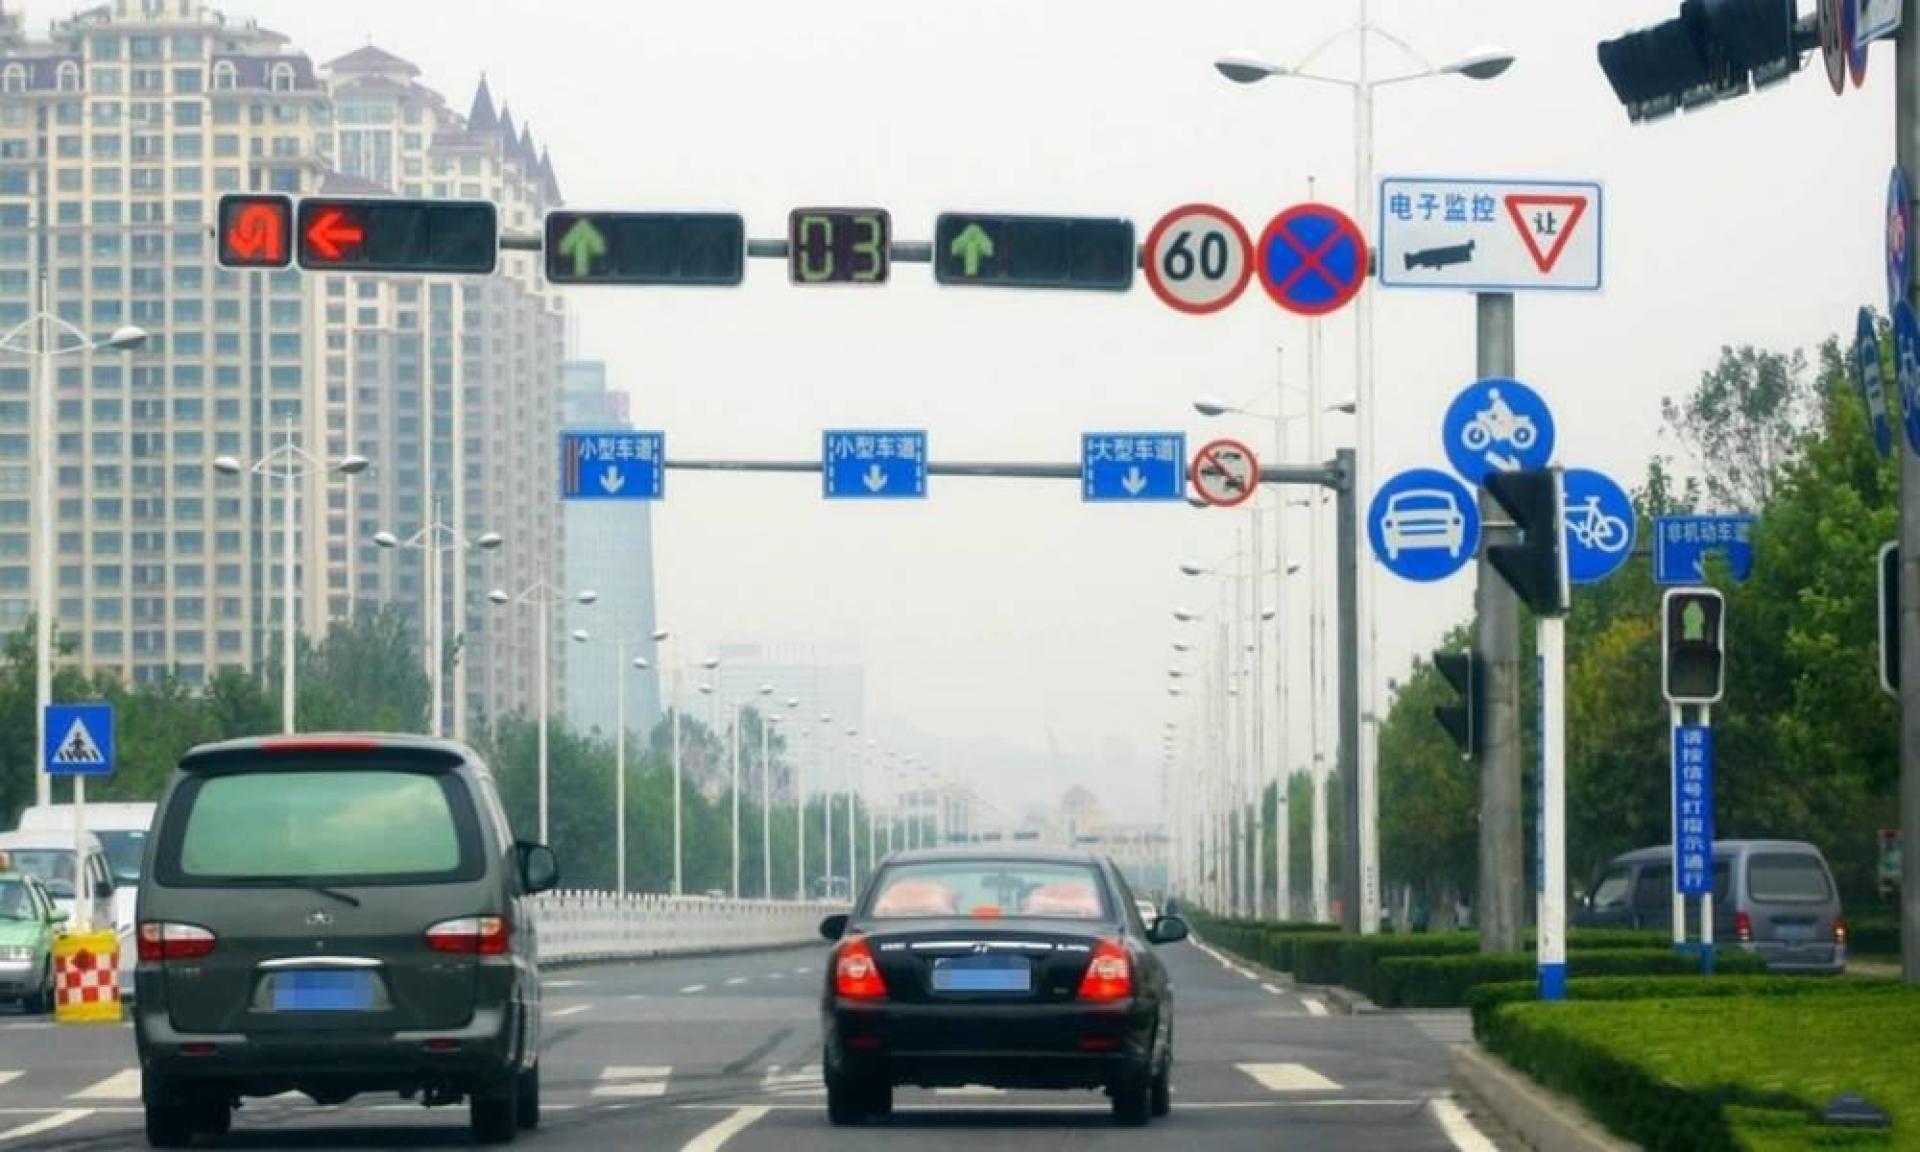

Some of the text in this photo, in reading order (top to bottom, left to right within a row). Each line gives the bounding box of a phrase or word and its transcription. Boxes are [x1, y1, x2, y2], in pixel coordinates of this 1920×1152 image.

[1389, 192, 1496, 222] 电子监控
[1533, 211, 1557, 235] 让
[801, 216, 880, 280] 03
[1163, 231, 1227, 281] 60
[579, 437, 652, 461] 小型车道
[834, 436, 915, 459] 小型车道
[1092, 439, 1174, 461] 大型车道
